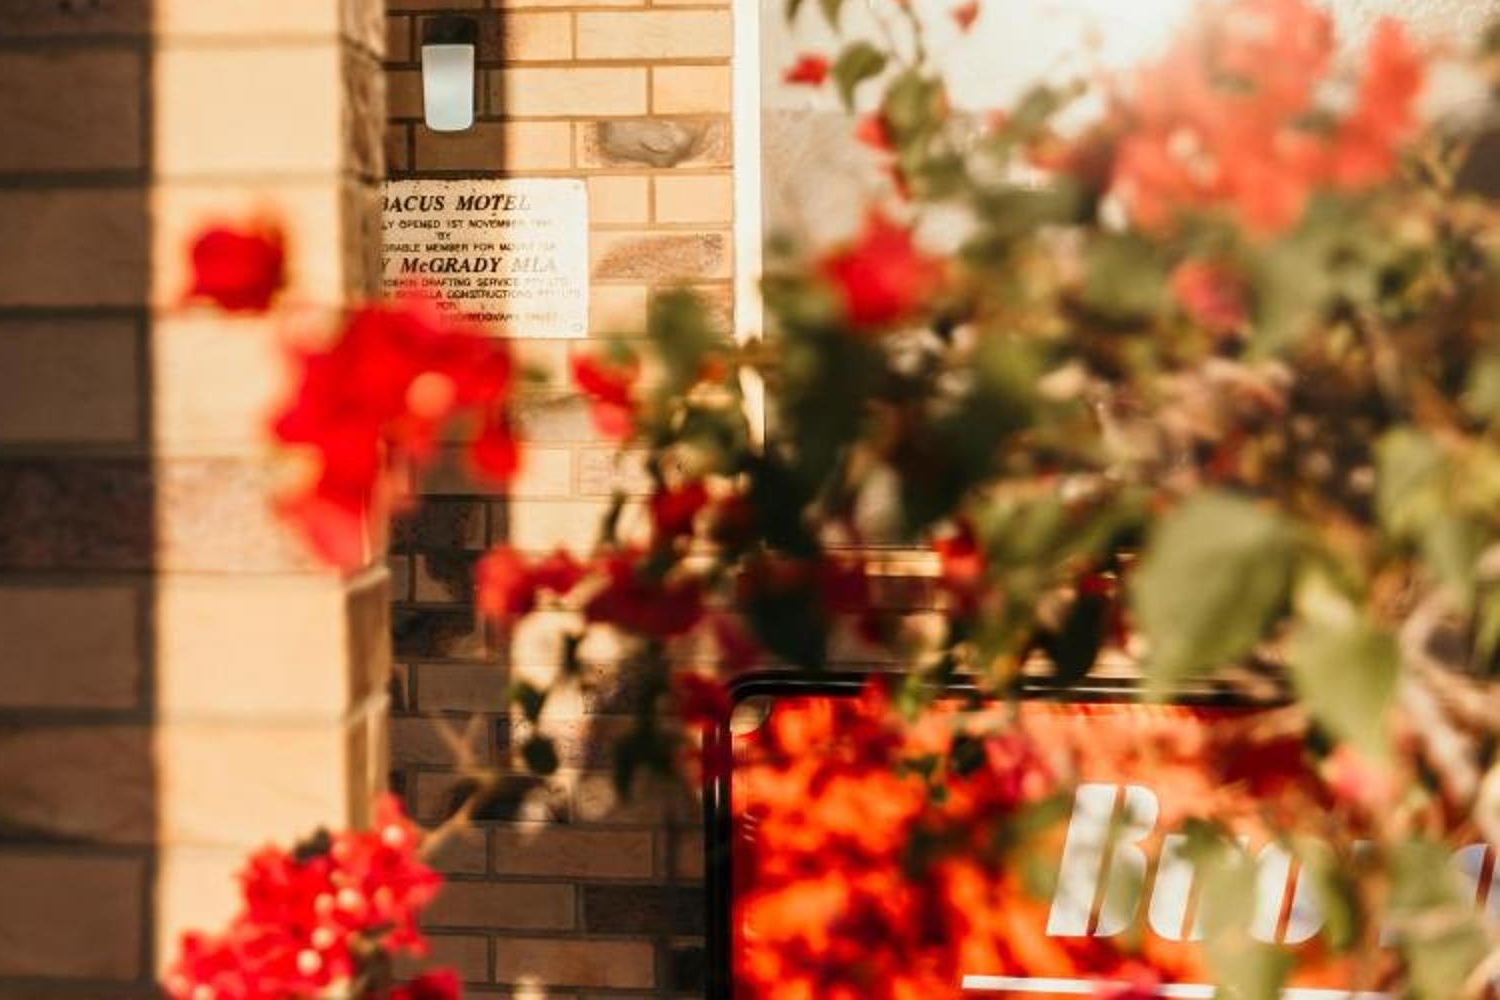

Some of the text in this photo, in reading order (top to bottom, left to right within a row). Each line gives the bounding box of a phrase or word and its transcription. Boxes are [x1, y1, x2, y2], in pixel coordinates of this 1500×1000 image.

[455, 194, 532, 211] MOTEL
[399, 219, 441, 229] OPENED
[425, 243, 468, 252] MEMBER
[474, 243, 495, 251] FOR
[400, 257, 503, 274] McGRADY
[511, 257, 557, 274] MLA
[421, 278, 471, 287] DRAFTING
